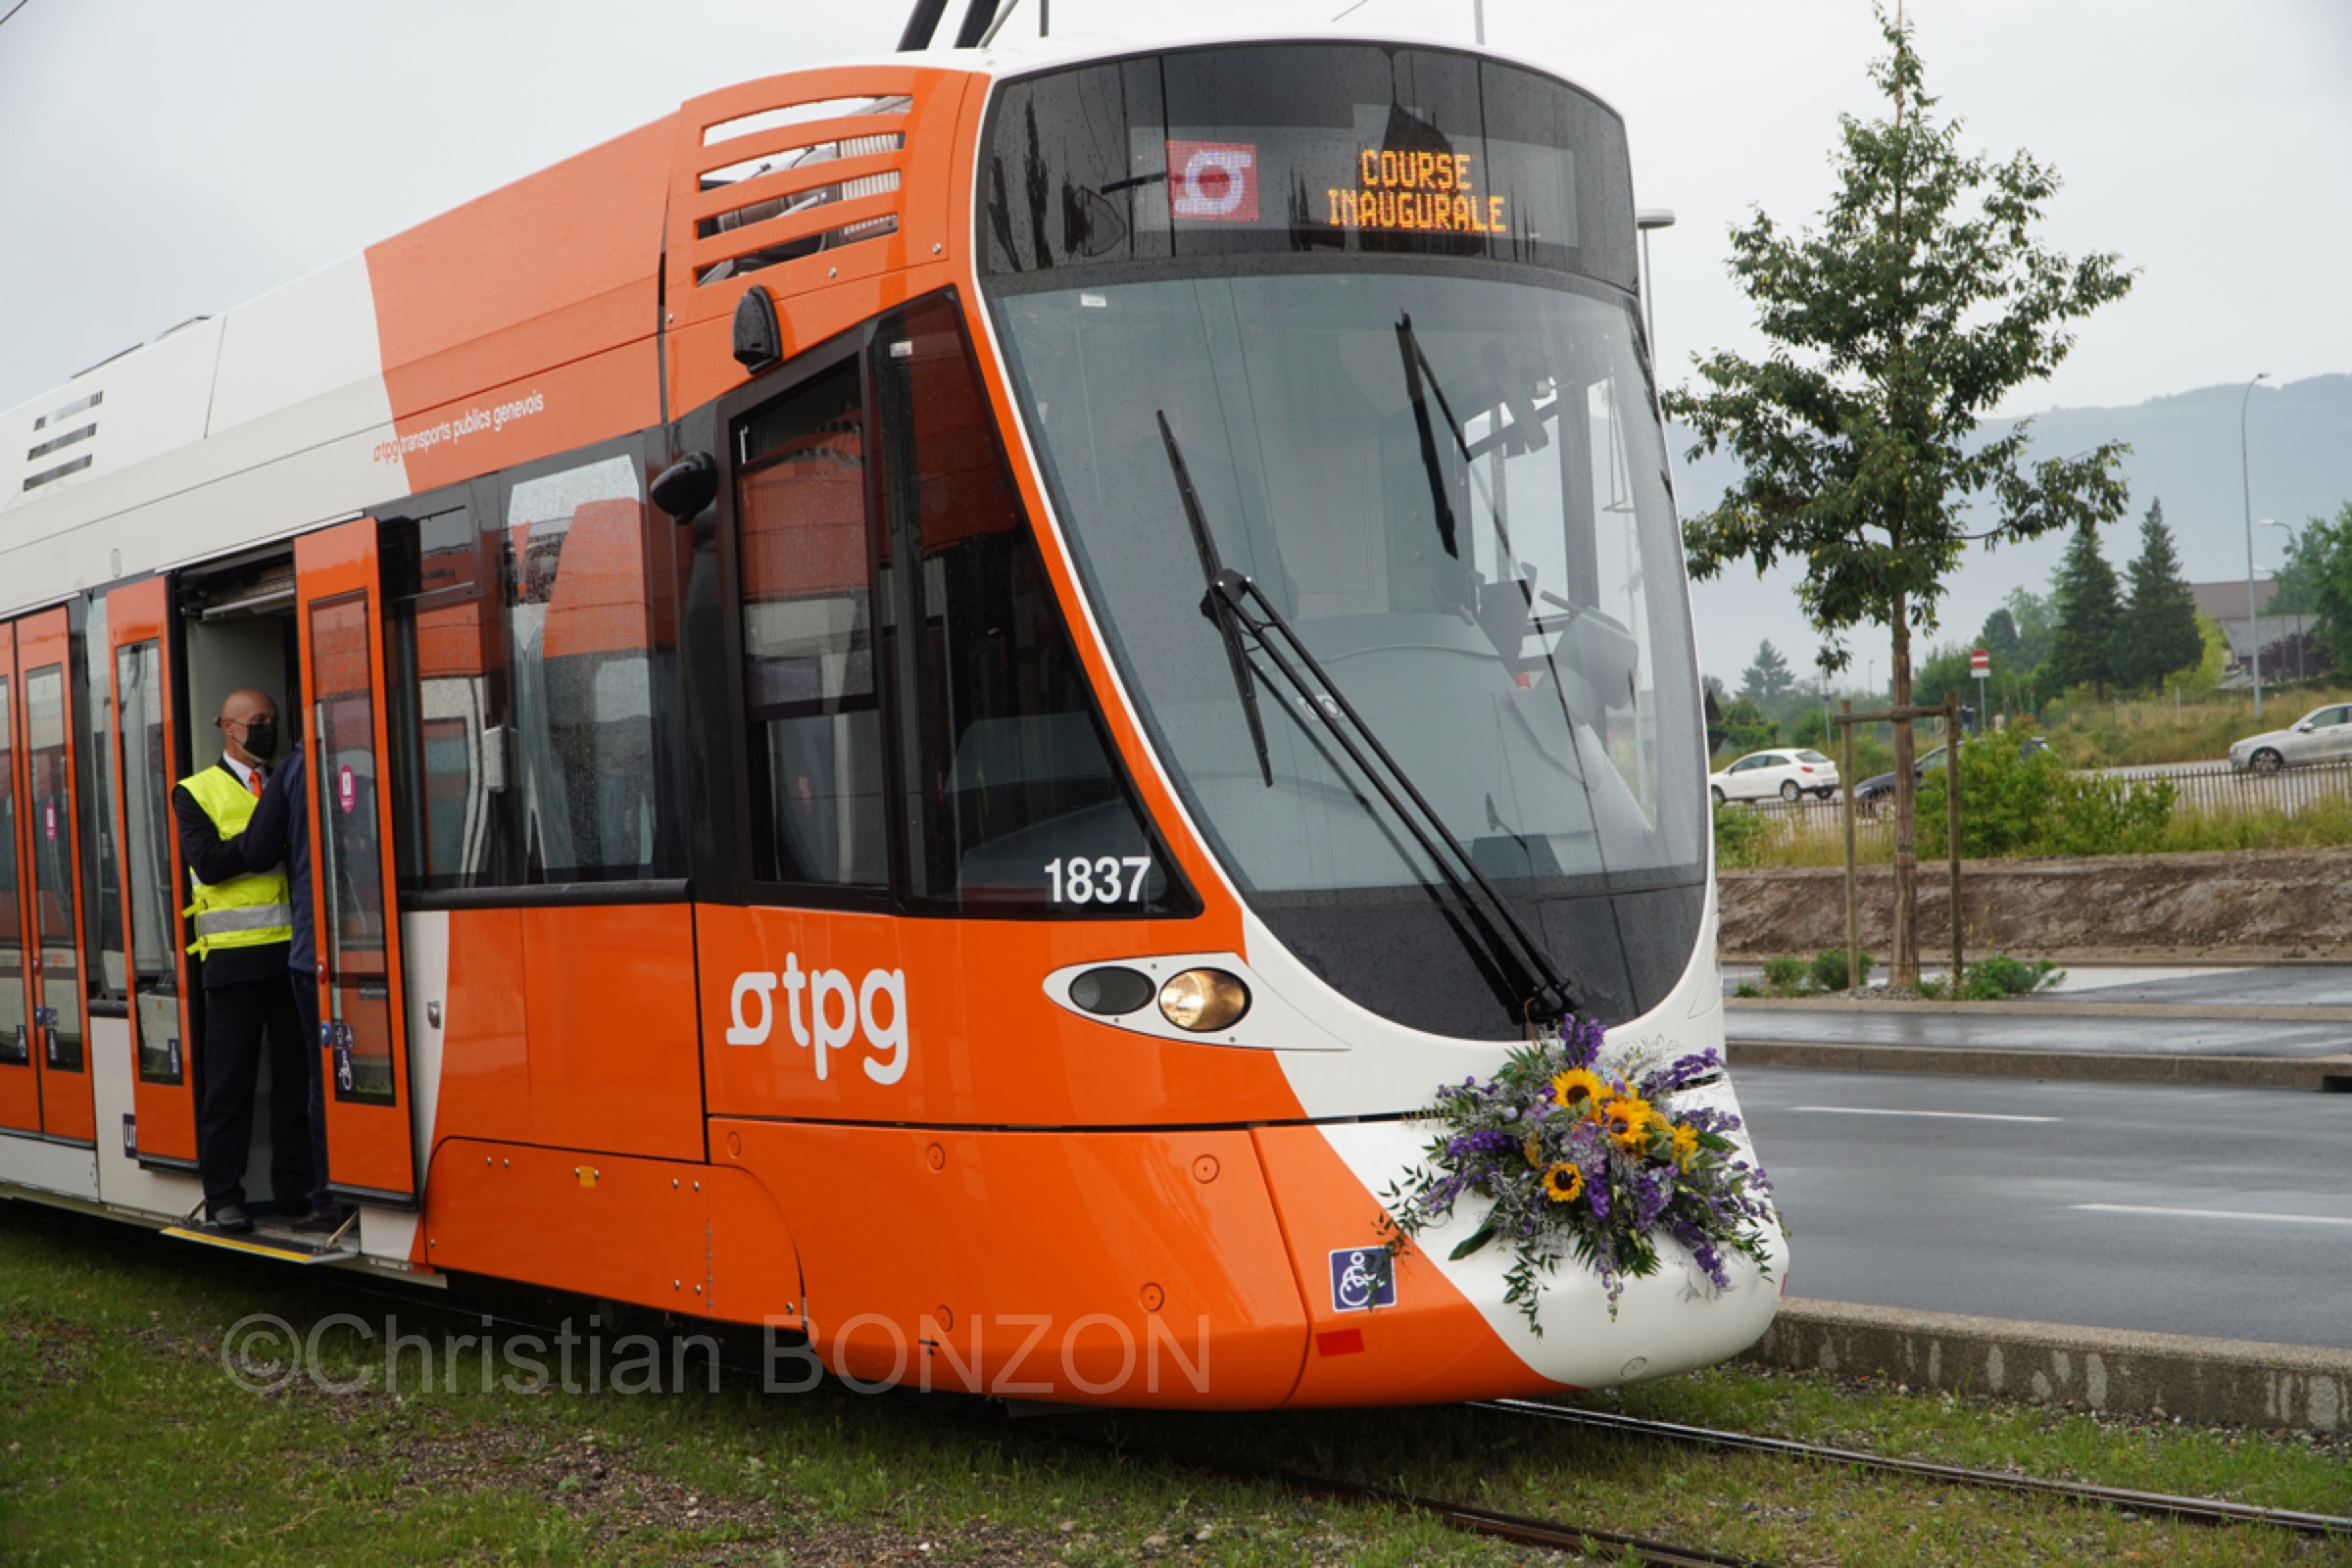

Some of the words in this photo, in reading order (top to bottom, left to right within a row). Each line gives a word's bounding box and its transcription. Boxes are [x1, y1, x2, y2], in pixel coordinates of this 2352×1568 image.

[1361, 148, 1472, 190] COURSE
[1328, 188, 1505, 231] INAUGURALE
[400, 422, 451, 454] transports
[453, 407, 491, 445] publics
[494, 389, 543, 432] genevois
[1044, 856, 1152, 904] 1837
